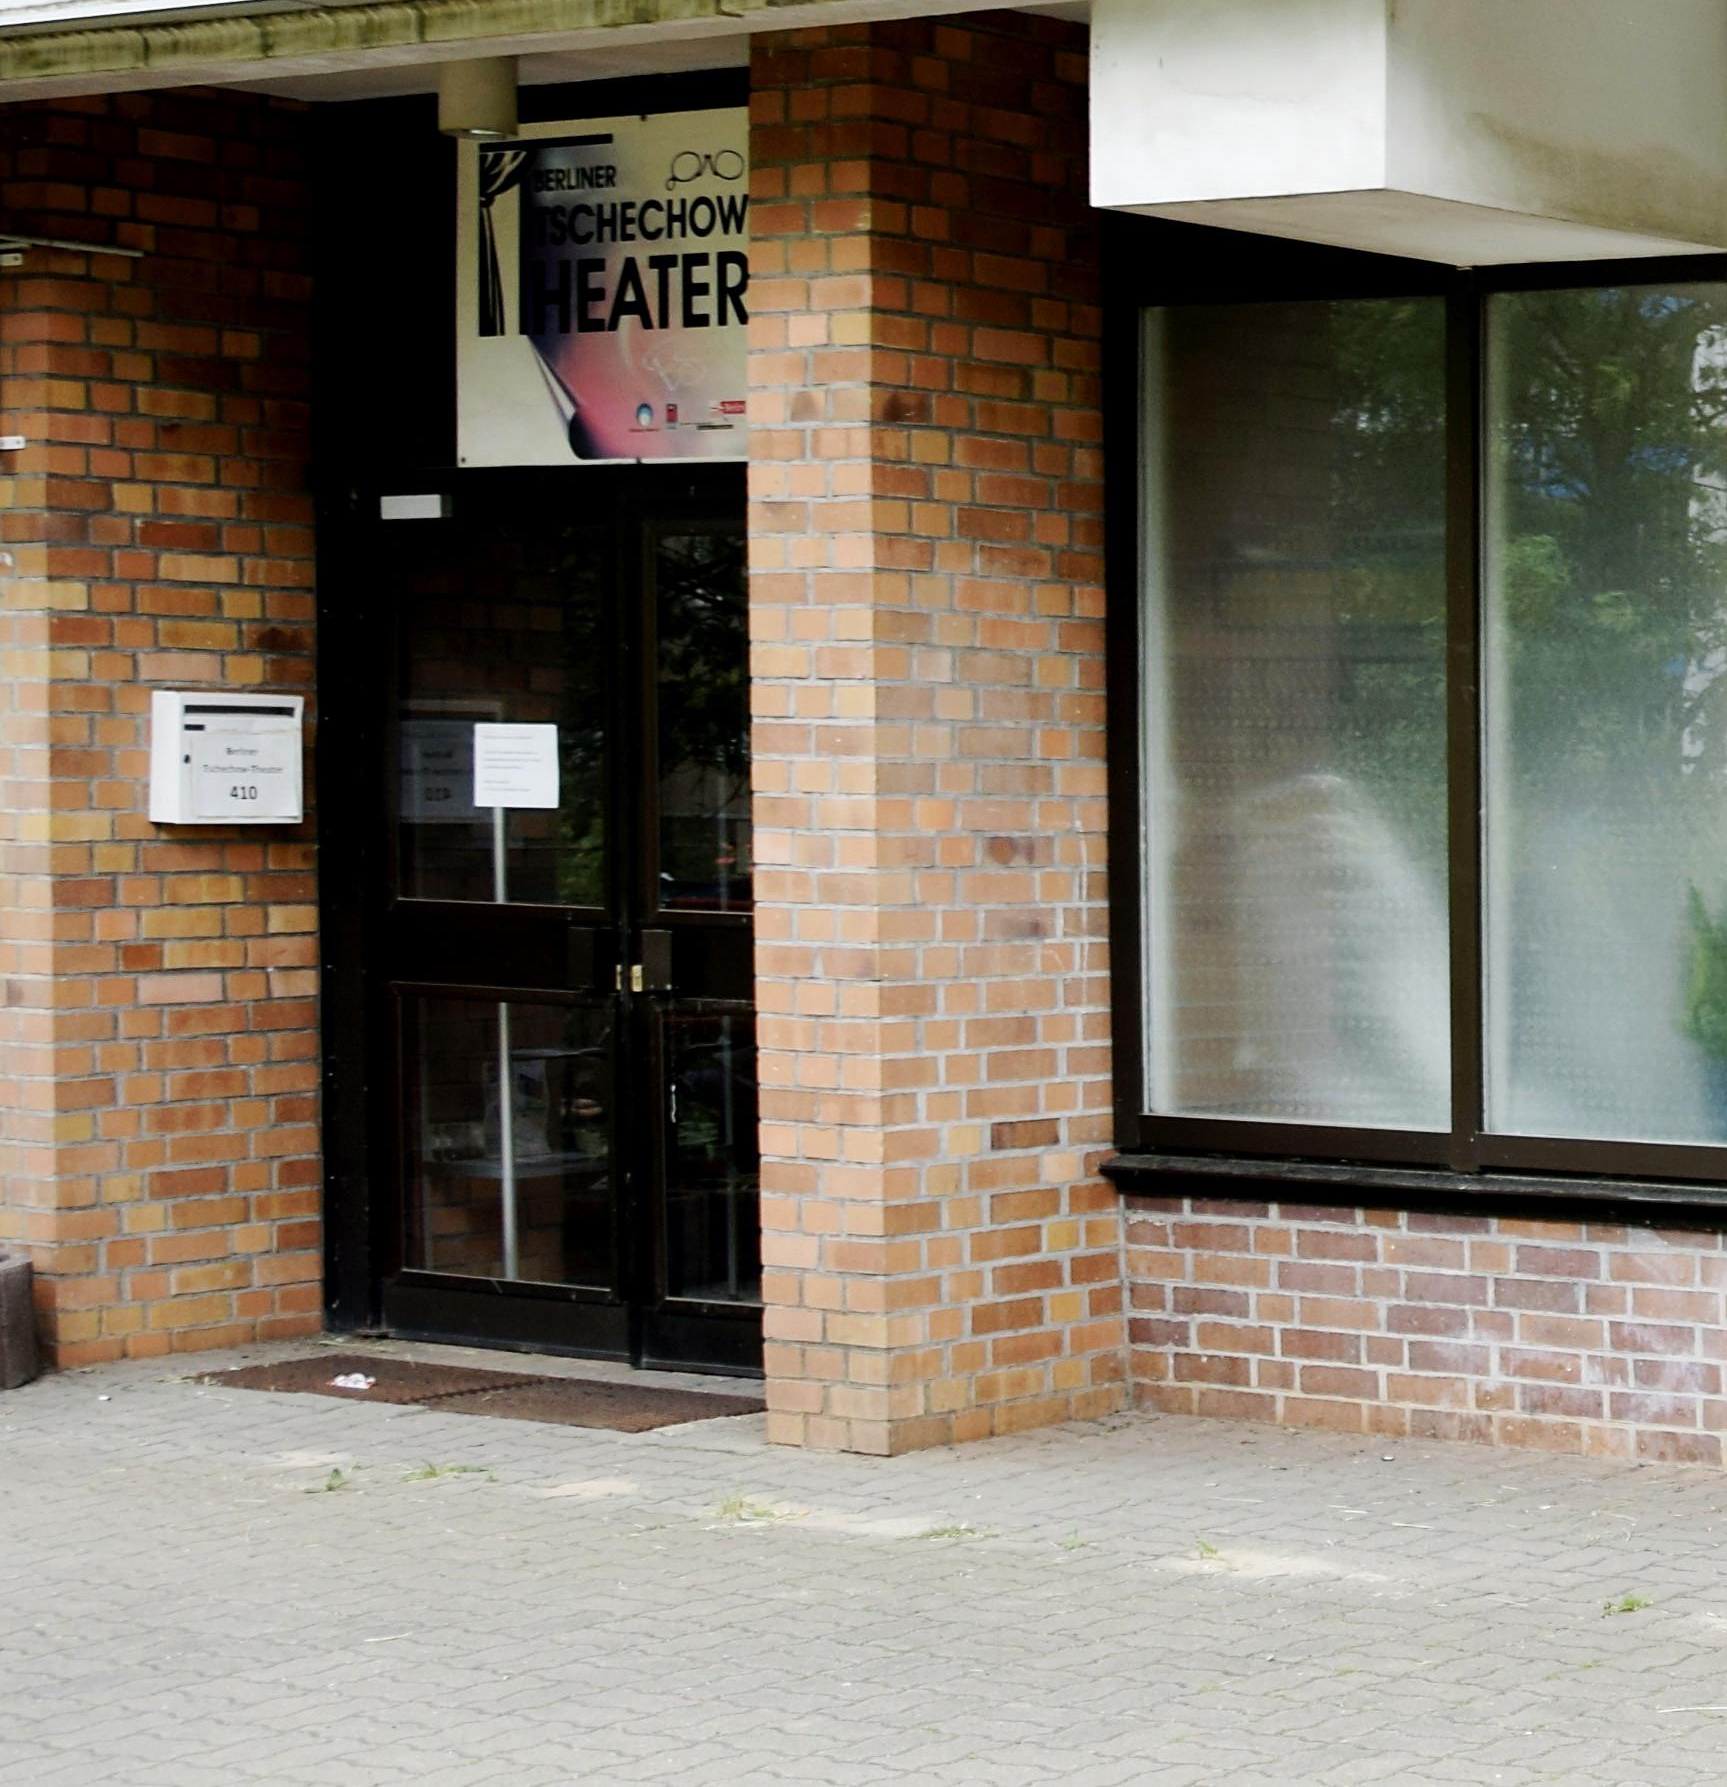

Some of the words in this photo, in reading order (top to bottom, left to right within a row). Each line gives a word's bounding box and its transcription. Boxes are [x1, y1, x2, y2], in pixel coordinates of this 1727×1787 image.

[534, 165, 616, 193] BERLINER
[533, 194, 750, 247] TSCHECHOW
[229, 785, 258, 800] 410
